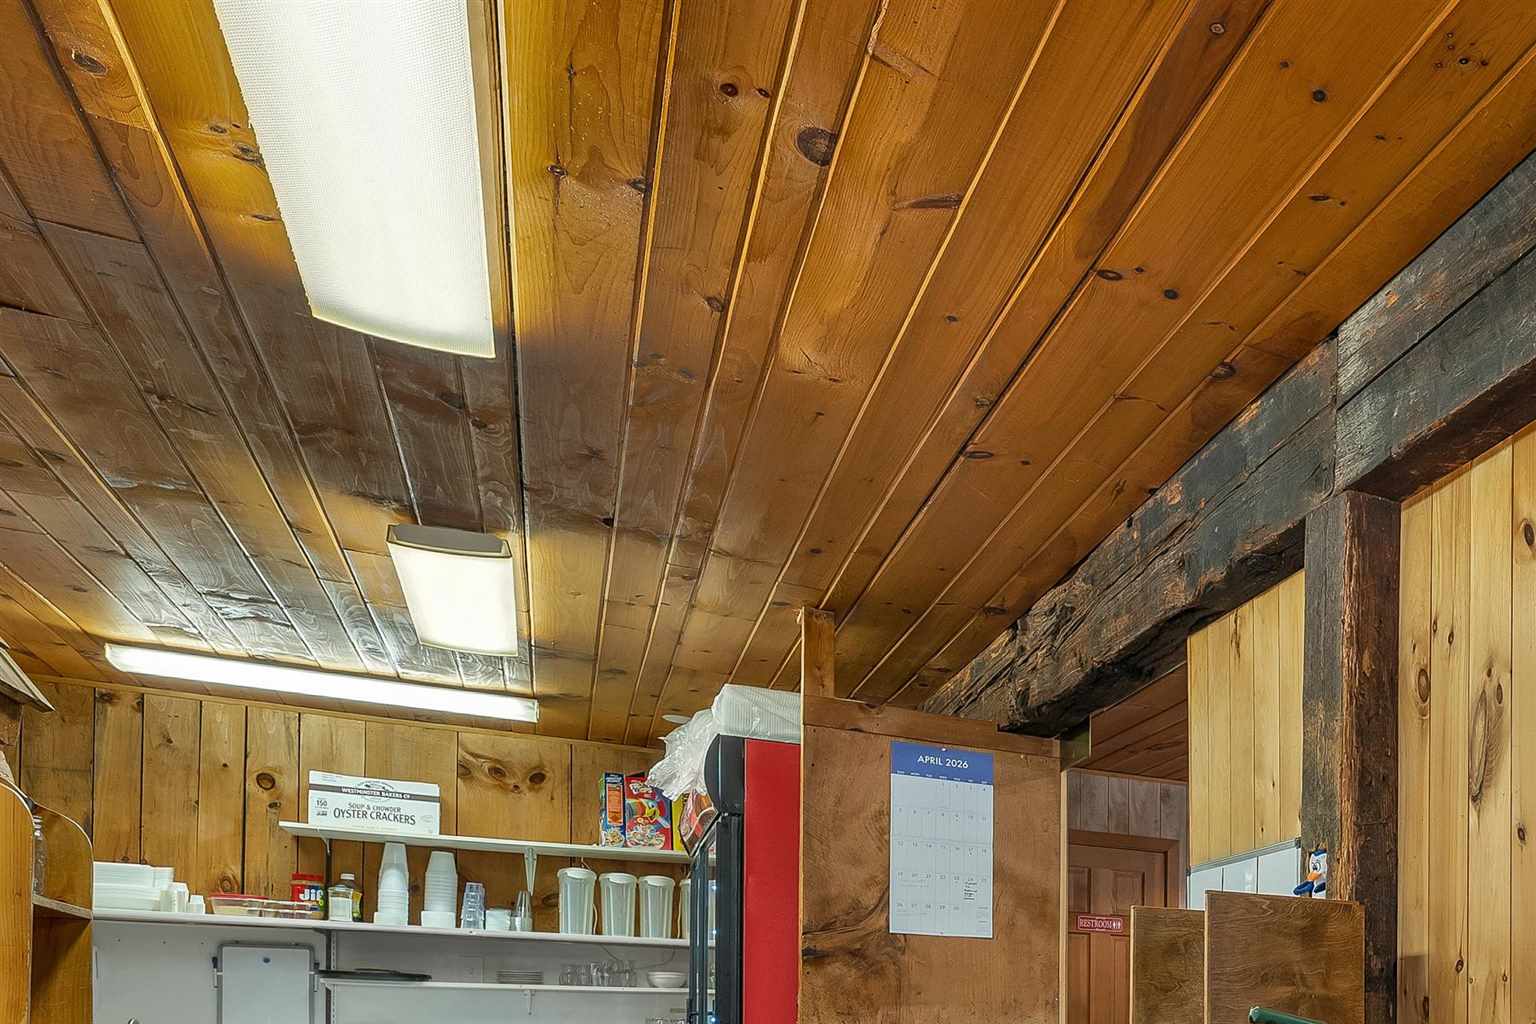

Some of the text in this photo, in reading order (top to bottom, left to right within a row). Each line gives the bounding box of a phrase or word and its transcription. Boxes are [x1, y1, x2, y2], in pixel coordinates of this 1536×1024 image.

[917, 755, 969, 769] APRIL 2026
[333, 808, 416, 825] OYSTER CRACKERS
[1079, 919, 1112, 929] RESTROOM
